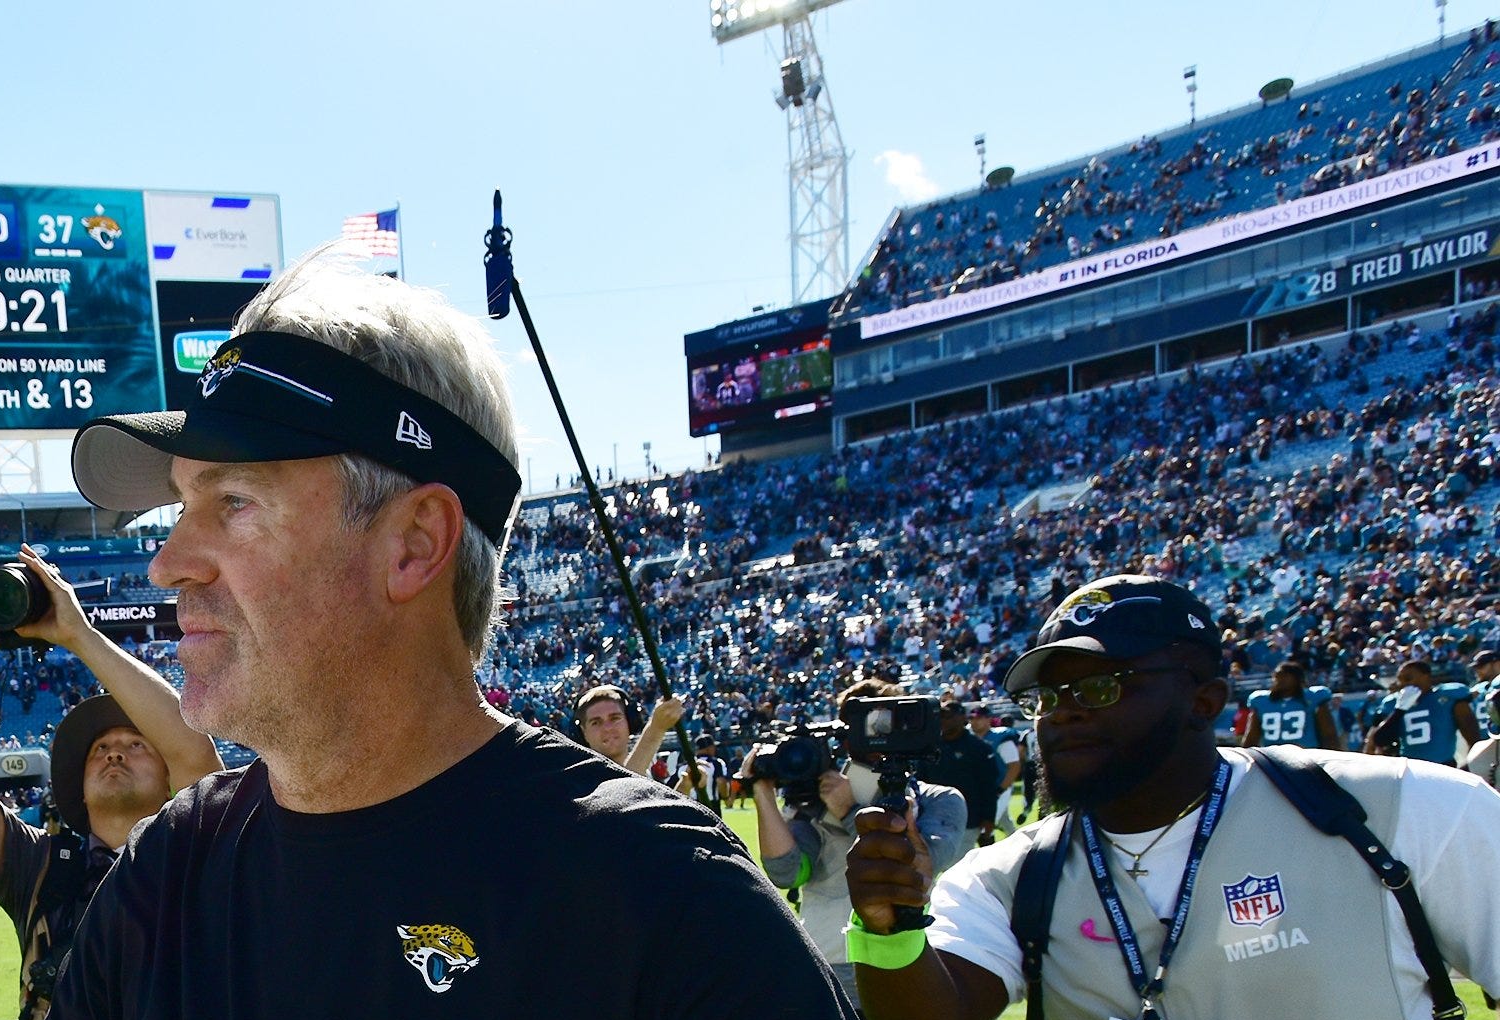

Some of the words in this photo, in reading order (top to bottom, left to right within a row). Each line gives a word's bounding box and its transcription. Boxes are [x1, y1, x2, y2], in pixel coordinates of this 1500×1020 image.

[1466, 150, 1488, 167] #1
[1296, 162, 1452, 218] REHABILITATION
[38, 214, 74, 244] 37
[4, 267, 71, 284] QUARTER
[1059, 269, 1077, 284] #1
[1081, 262, 1099, 278] IN
[1103, 242, 1179, 272] FLORIDA
[1307, 270, 1337, 297] 28
[1352, 252, 1403, 286] FRED
[1411, 230, 1489, 272] TAYLOR
[182, 337, 223, 358] WAS
[19, 358, 37, 373] 50
[38, 358, 75, 374] YARD
[76, 359, 107, 374] LINE
[26, 379, 51, 409] &
[59, 379, 94, 409] 13
[88, 606, 156, 625] AMERICAS
[1261, 711, 1306, 741] 93
[1404, 709, 1432, 745] 5
[6, 759, 24, 771] 149
[1201, 790, 1222, 837] JACKSONVILLE
[1214, 762, 1230, 792] JAGUARS
[1091, 852, 1107, 878] JAGUARS
[1170, 894, 1191, 943] JACKSONVILLE
[1185, 859, 1201, 892] JAGUARS
[1232, 894, 1280, 921] NFL
[1107, 898, 1132, 943] JACKSONVILLE
[1124, 941, 1143, 975] JAGUARS
[1223, 927, 1310, 962] MEDIA
